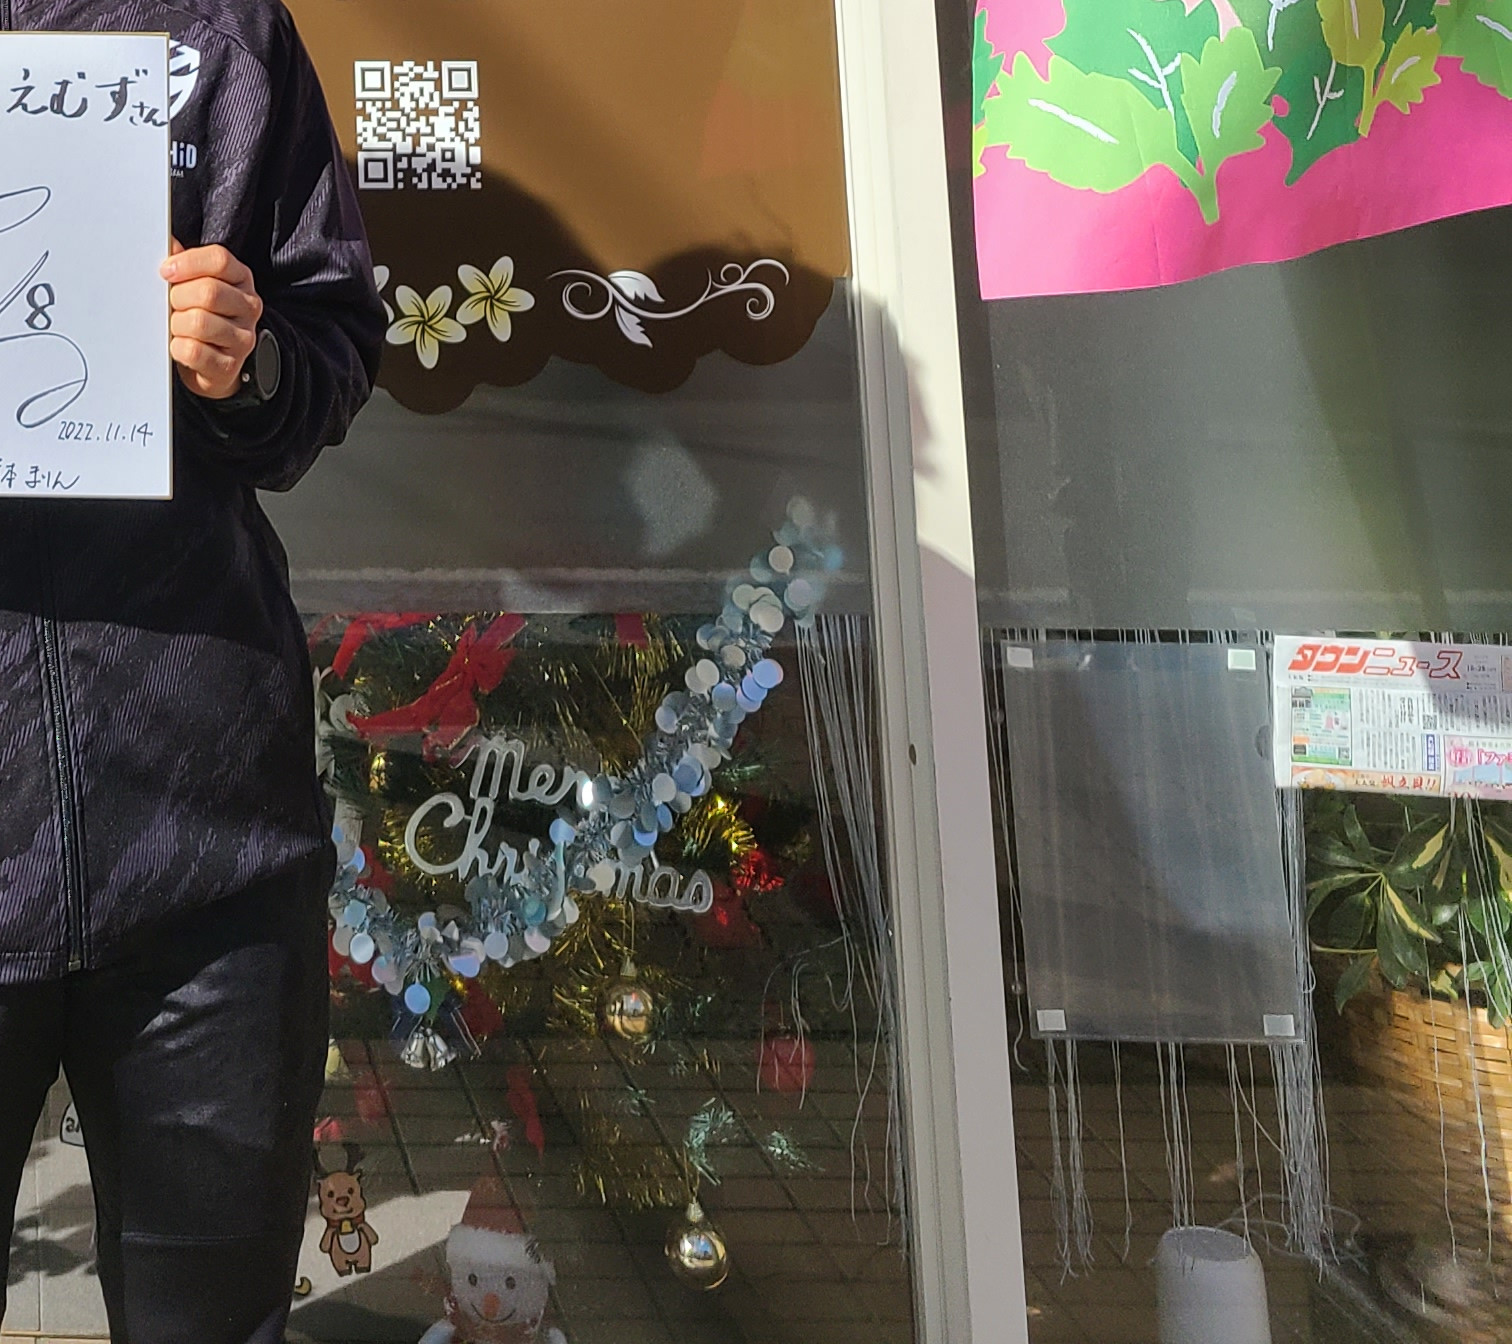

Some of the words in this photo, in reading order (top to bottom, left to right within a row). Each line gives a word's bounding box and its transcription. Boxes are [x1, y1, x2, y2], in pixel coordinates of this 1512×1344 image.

[57, 420, 154, 447] 2022.11.14
[1288, 643, 1463, 679] タウンニュース
